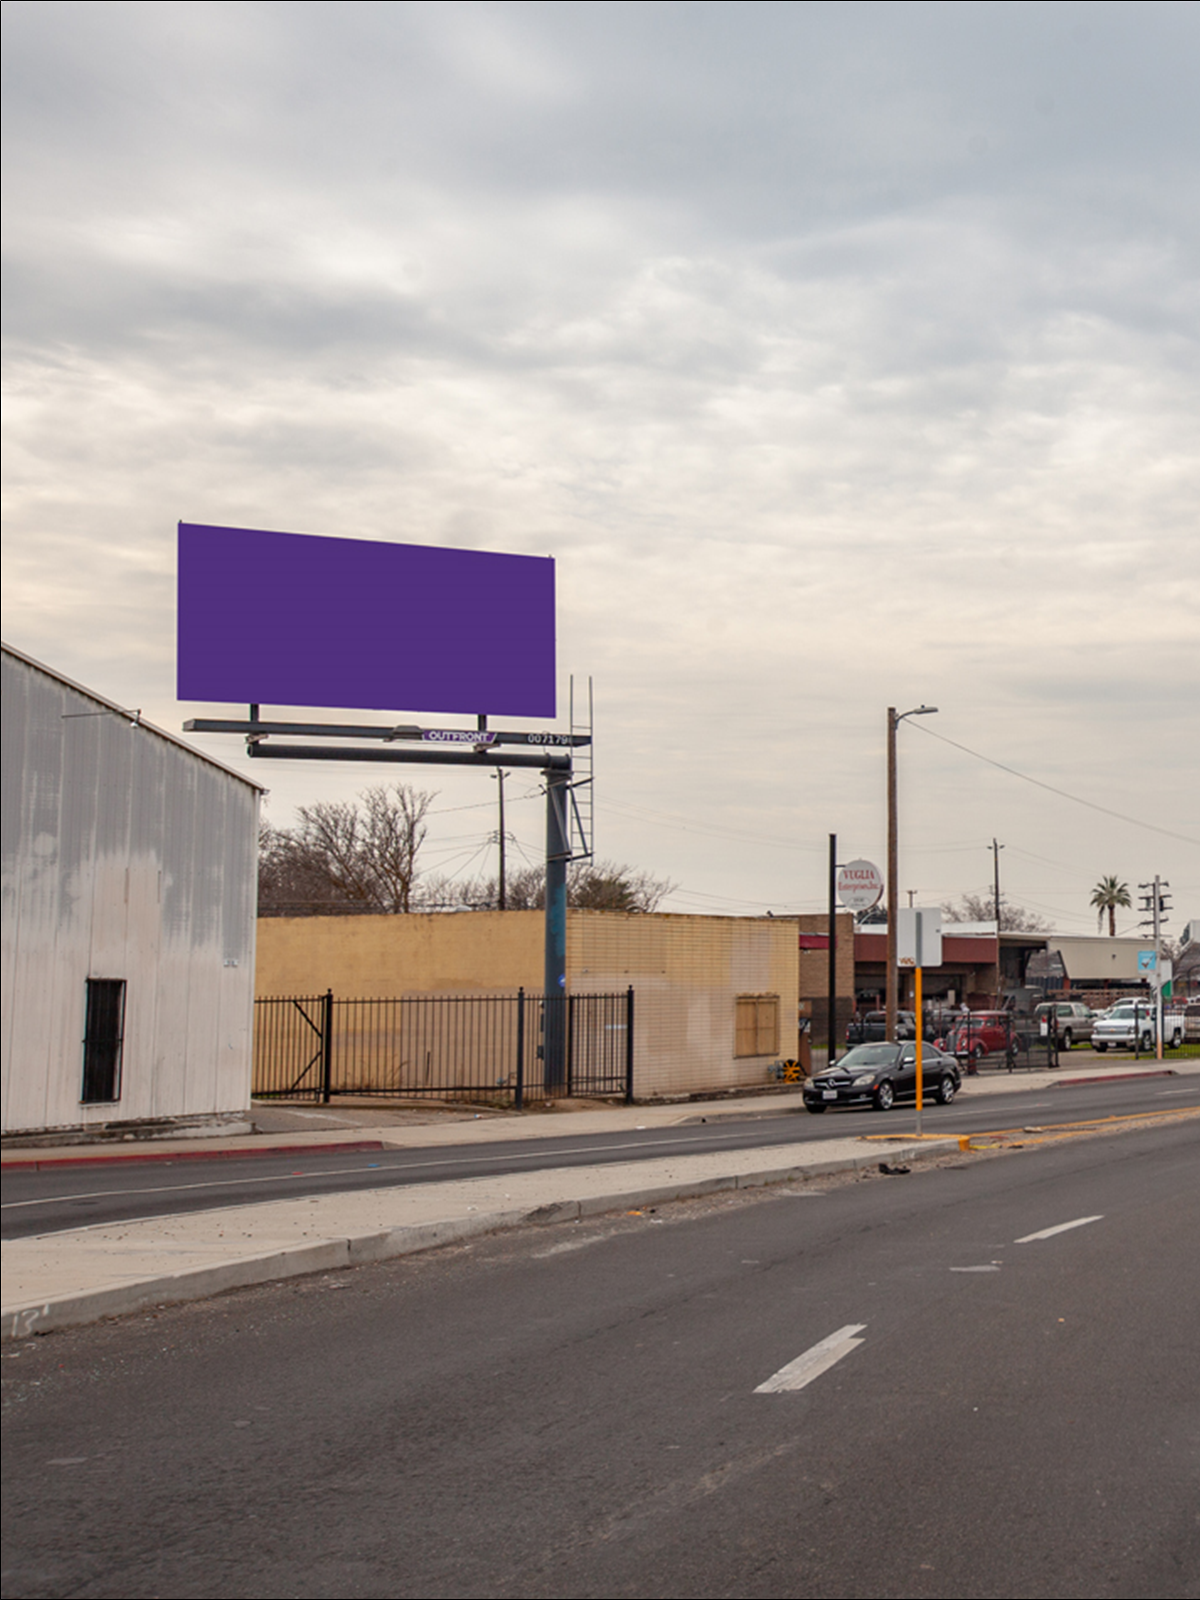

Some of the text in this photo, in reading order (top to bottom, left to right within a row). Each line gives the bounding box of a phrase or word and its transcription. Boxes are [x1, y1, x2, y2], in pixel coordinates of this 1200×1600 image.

[428, 730, 489, 742] OUTFRONT
[527, 733, 569, 745] 007179
[843, 869, 875, 880] VUGLIA
